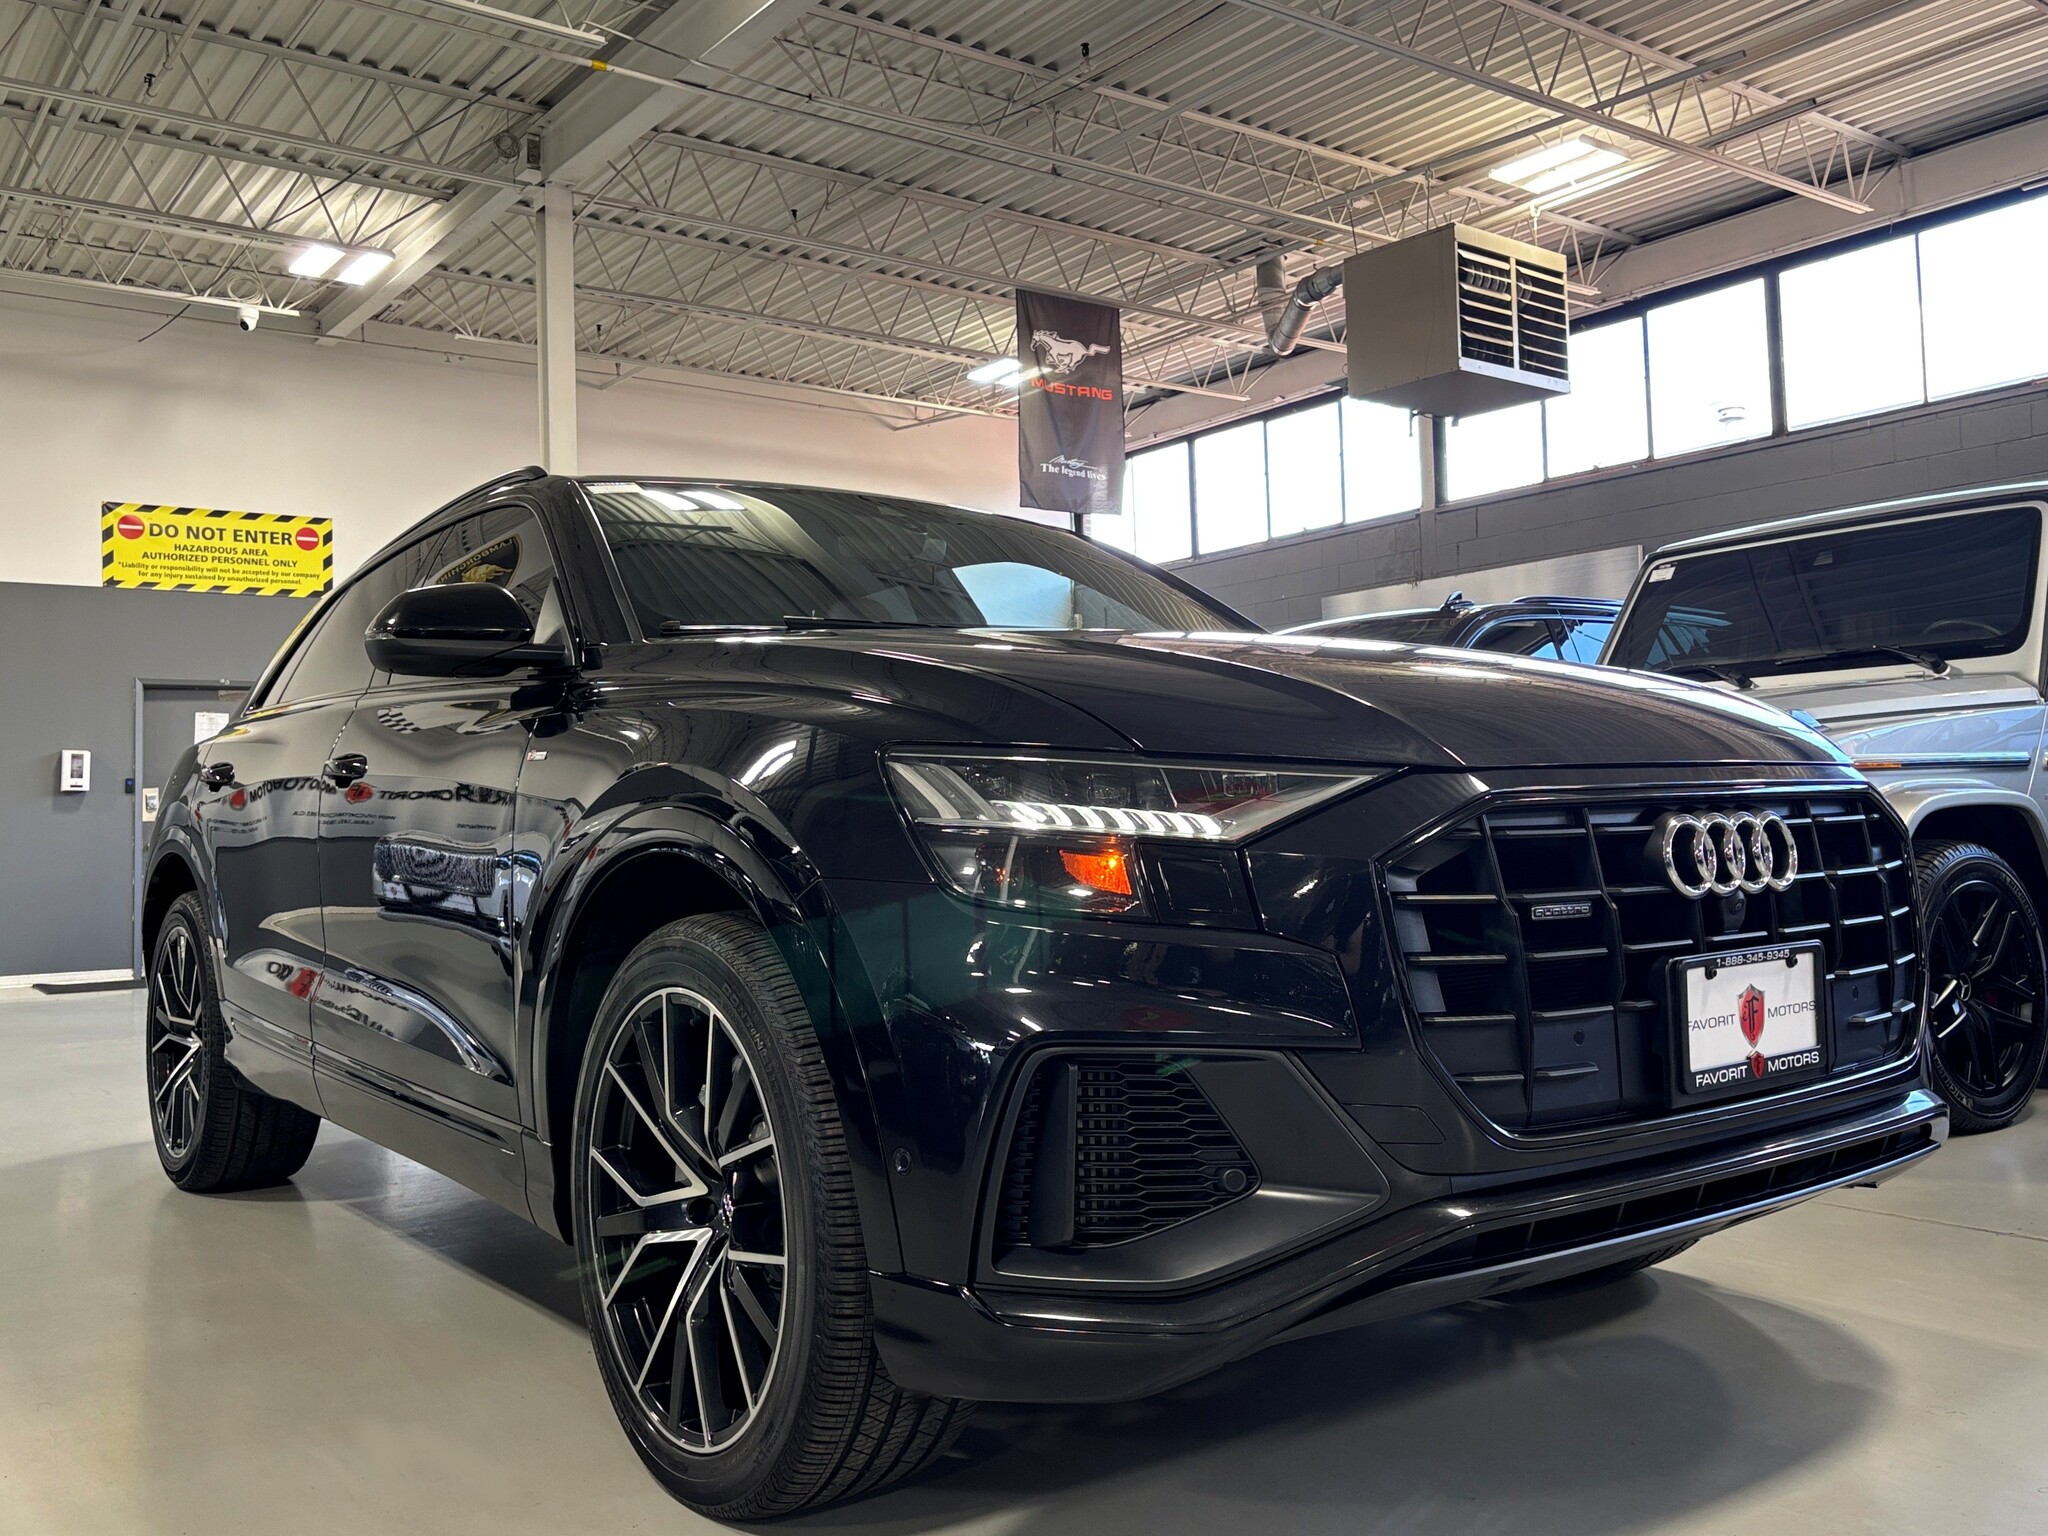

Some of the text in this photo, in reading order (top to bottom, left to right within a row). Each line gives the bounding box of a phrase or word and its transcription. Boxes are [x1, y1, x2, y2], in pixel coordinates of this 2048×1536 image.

[1031, 377, 1112, 400] MUSTANG
[1040, 463, 1107, 480] The legend lives
[149, 523, 293, 546] DO NOT ENTER
[174, 544, 268, 556] HAZARDOUS AREA
[142, 552, 298, 568] AUTHORIZED PERSONNEL ONLY
[160, 564, 204, 573] responsibility
[242, 568, 270, 577] accepted
[292, 572, 320, 580] company
[164, 572, 183, 580] injury
[1535, 906, 1589, 917] quattro
[1716, 949, 1790, 967] 1-888-345-9345
[1767, 1000, 1816, 1019] MOTORS
[1695, 1065, 1748, 1087] FAVORIT
[1768, 1051, 1820, 1072] MOTORS
